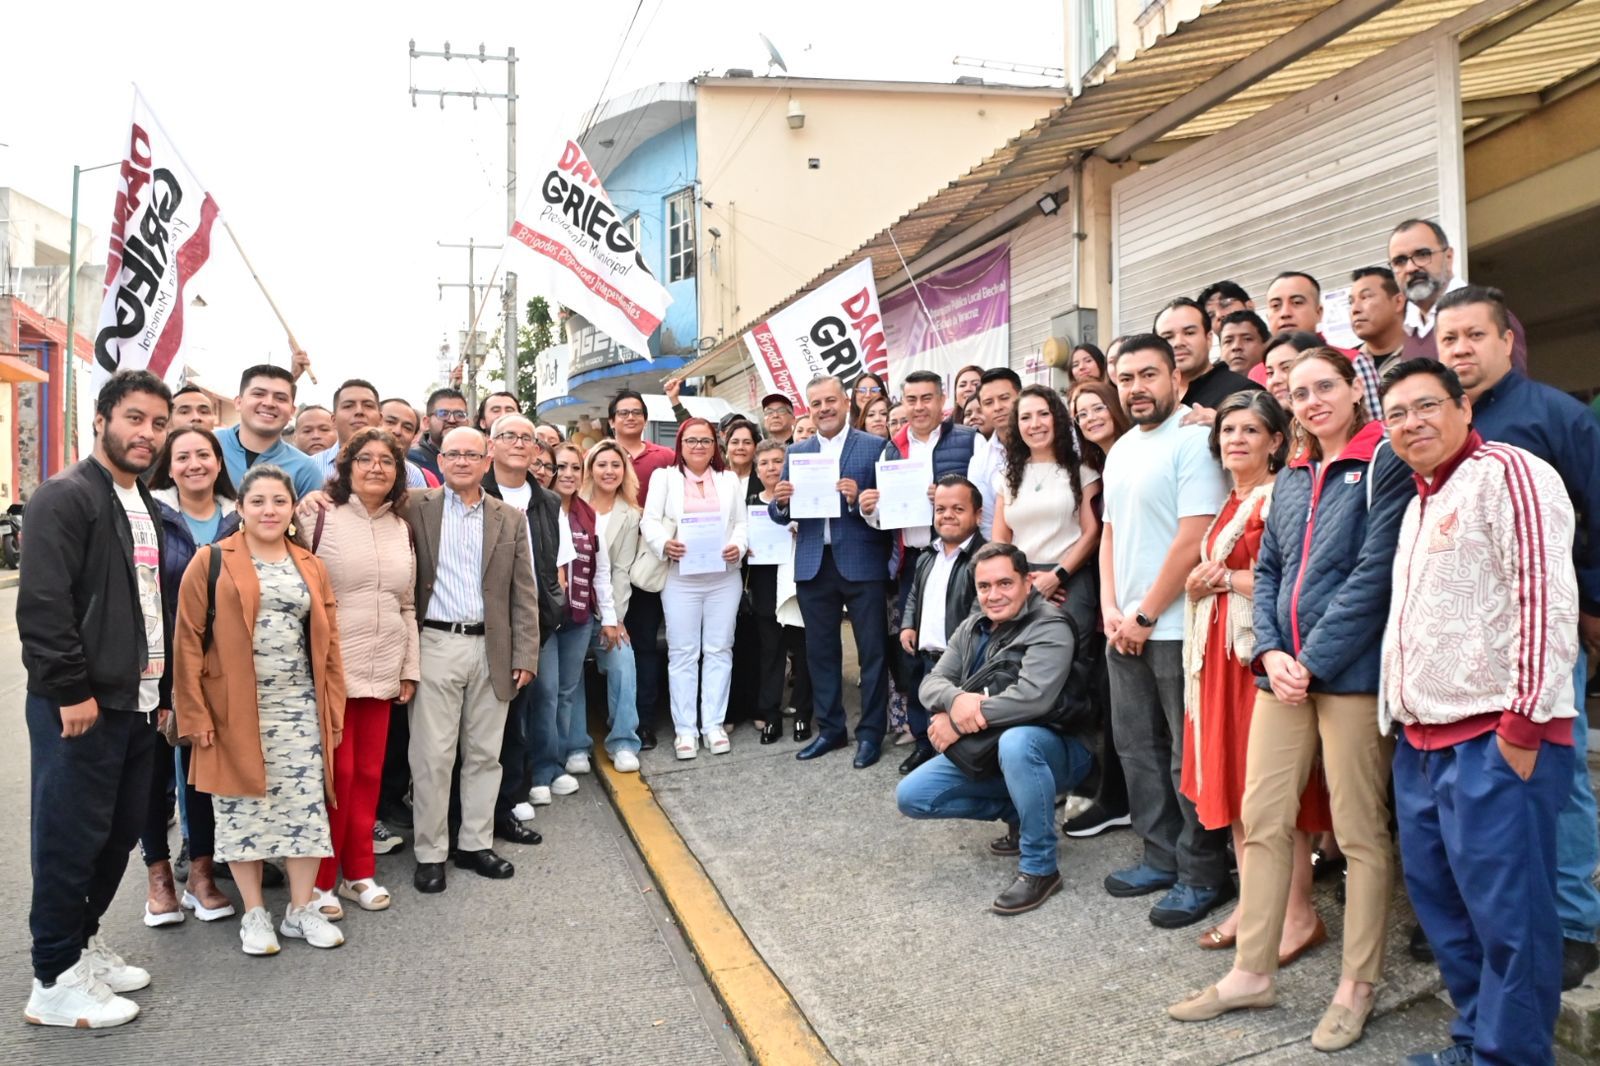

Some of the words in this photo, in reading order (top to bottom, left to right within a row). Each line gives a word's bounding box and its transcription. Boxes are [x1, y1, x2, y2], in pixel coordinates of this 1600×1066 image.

[516, 226, 560, 256] Brigadas
[588, 240, 634, 276] Municipal
[756, 331, 783, 369] Brigada
[773, 368, 802, 409] Popular
